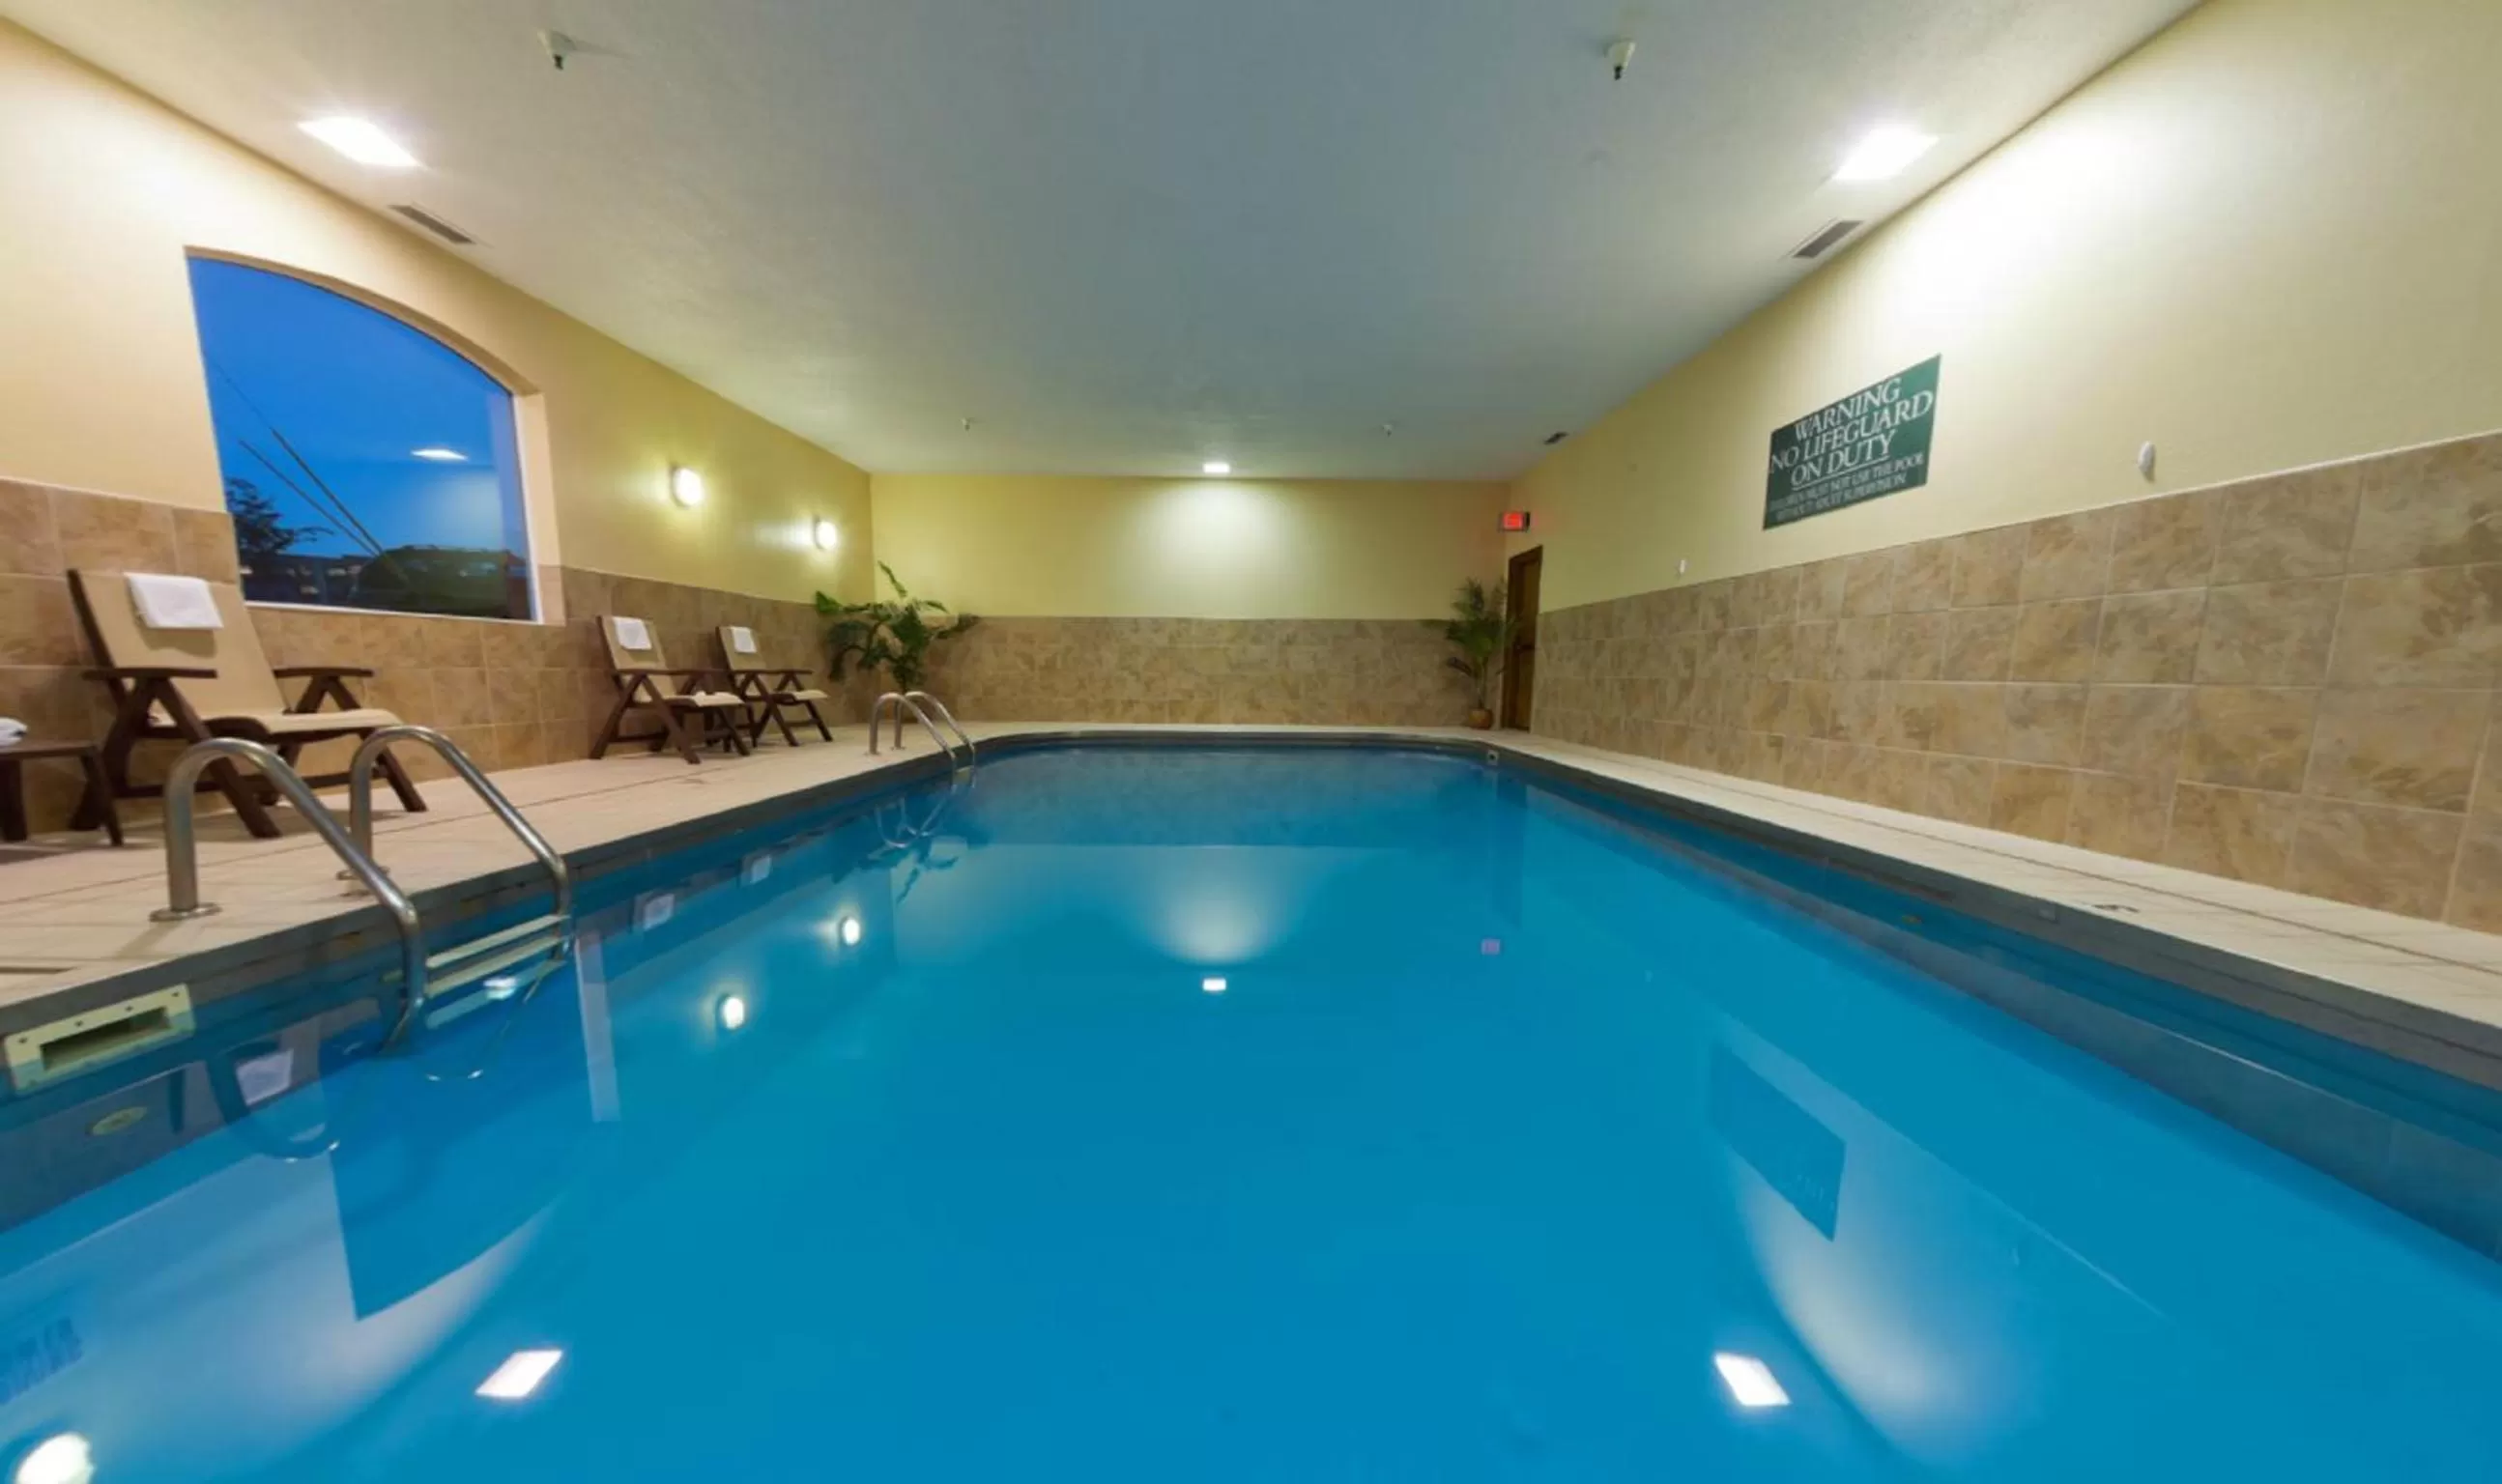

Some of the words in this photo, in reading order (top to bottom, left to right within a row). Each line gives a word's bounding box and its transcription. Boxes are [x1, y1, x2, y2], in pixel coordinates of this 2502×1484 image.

[1770, 445, 1799, 473] NO
[1802, 389, 1933, 461] LIFEGUARD
[1795, 377, 1901, 442] WARNING
[1791, 457, 1825, 485] ON
[1827, 429, 1896, 474] DUTY
